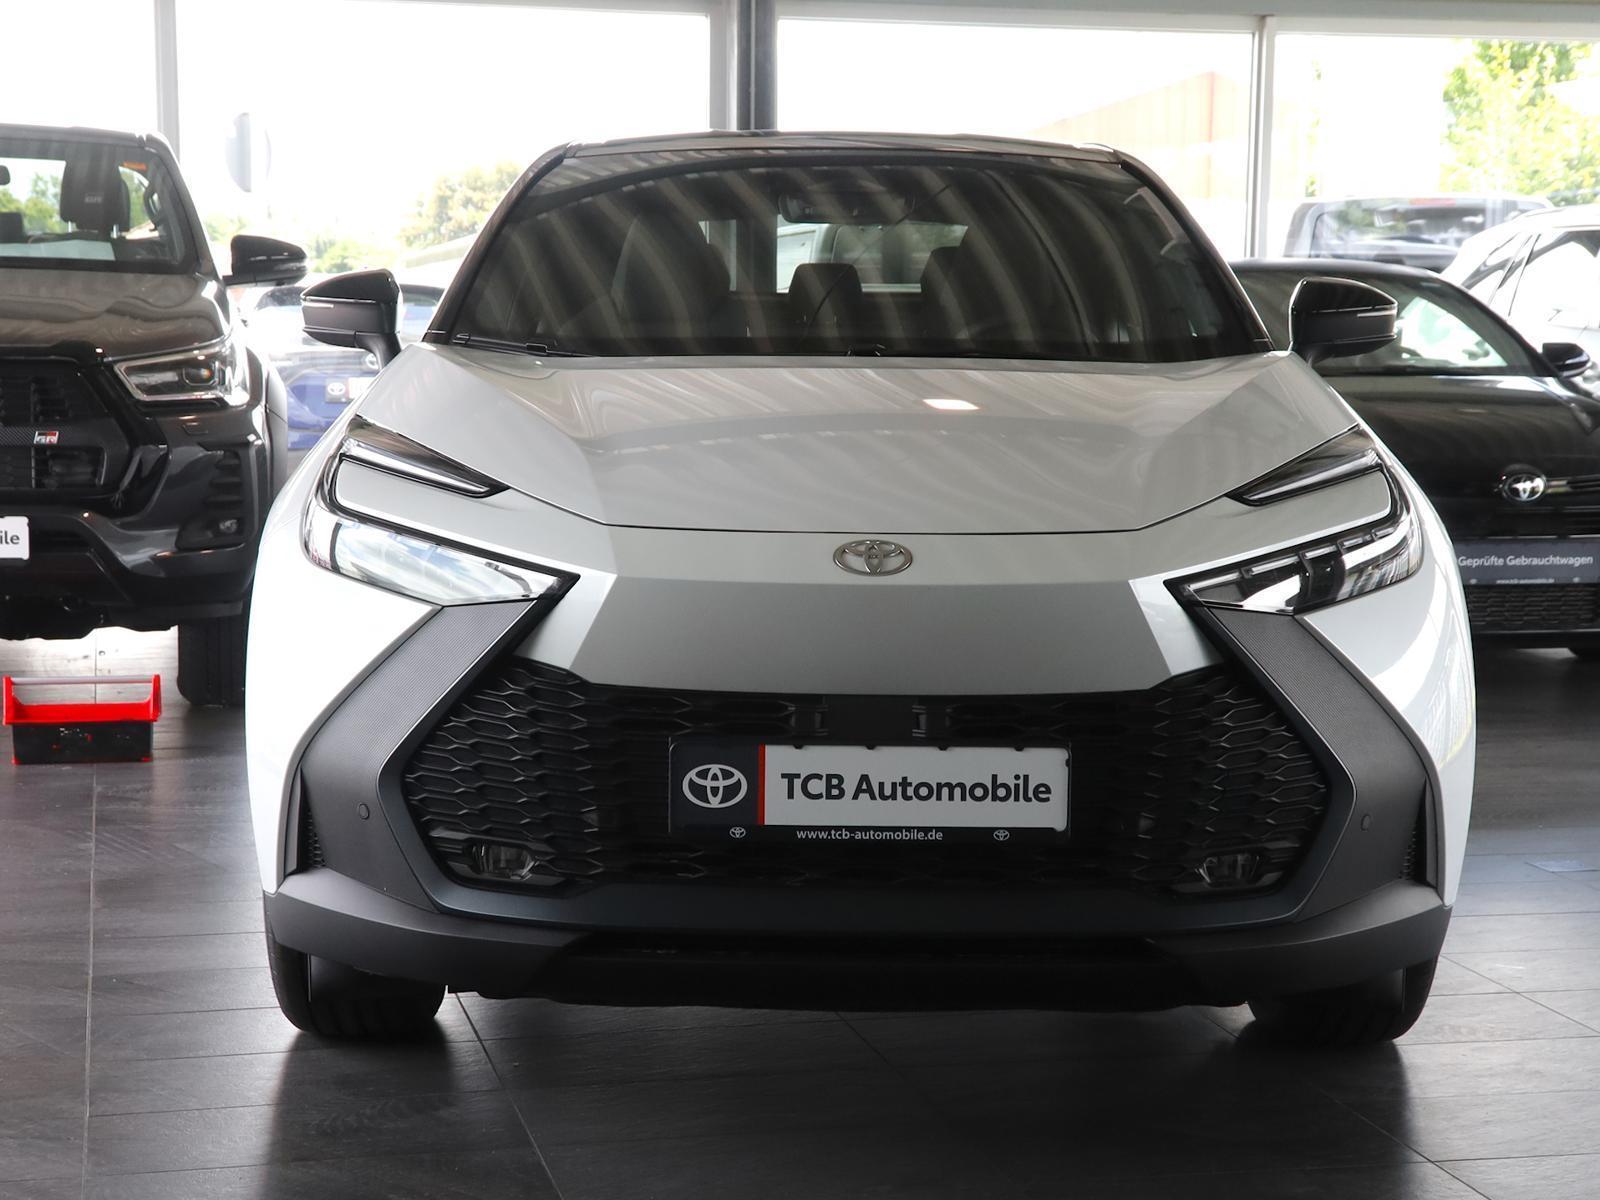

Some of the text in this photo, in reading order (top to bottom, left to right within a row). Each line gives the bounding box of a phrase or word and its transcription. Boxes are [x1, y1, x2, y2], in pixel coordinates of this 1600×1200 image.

[1458, 555, 1593, 568] Geprüfte Gebrauchtwagen
[780, 773, 1052, 803] TCB Automobile
[796, 828, 943, 841] www.tcb-automobile.de
